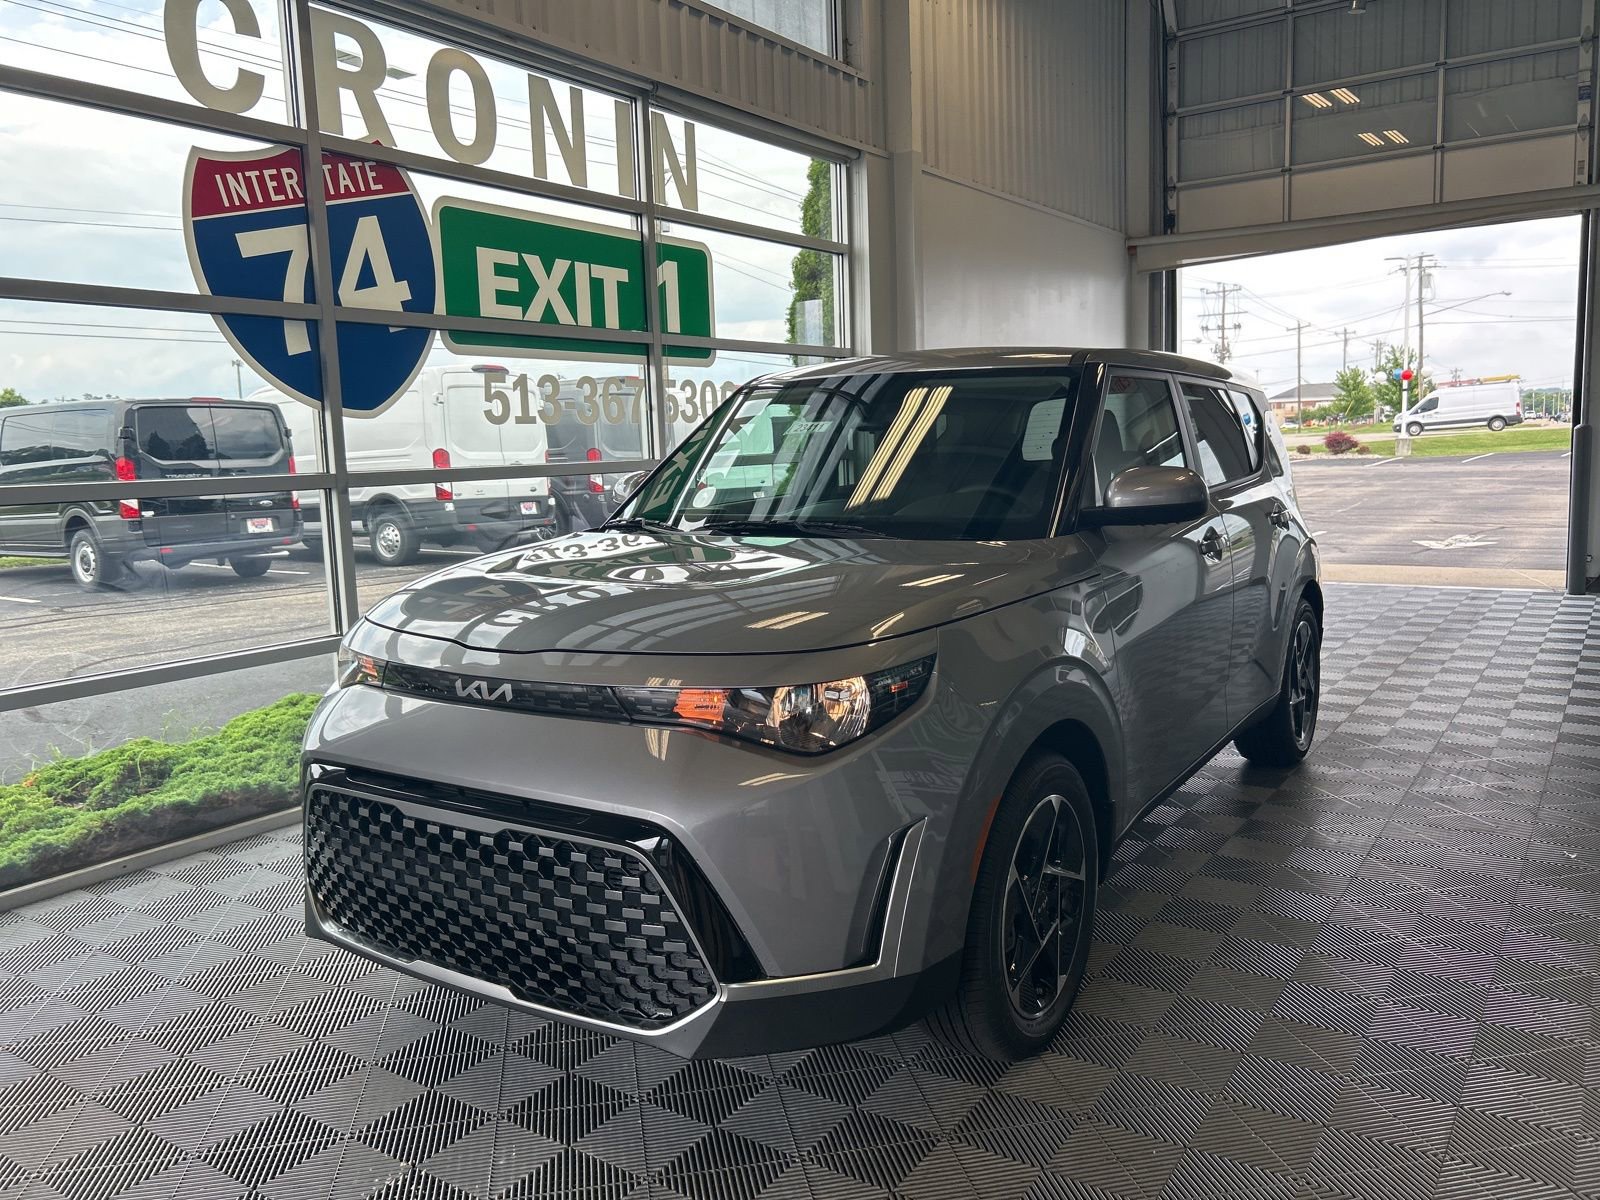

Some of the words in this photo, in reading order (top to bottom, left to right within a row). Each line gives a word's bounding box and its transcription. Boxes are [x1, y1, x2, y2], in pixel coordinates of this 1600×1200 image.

[163, 0, 699, 212] CRONIN
[215, 160, 384, 208] INTERTATE
[234, 215, 413, 356] 74
[475, 245, 629, 330] EXIT
[656, 260, 681, 334] 1
[455, 678, 513, 702] KIA
